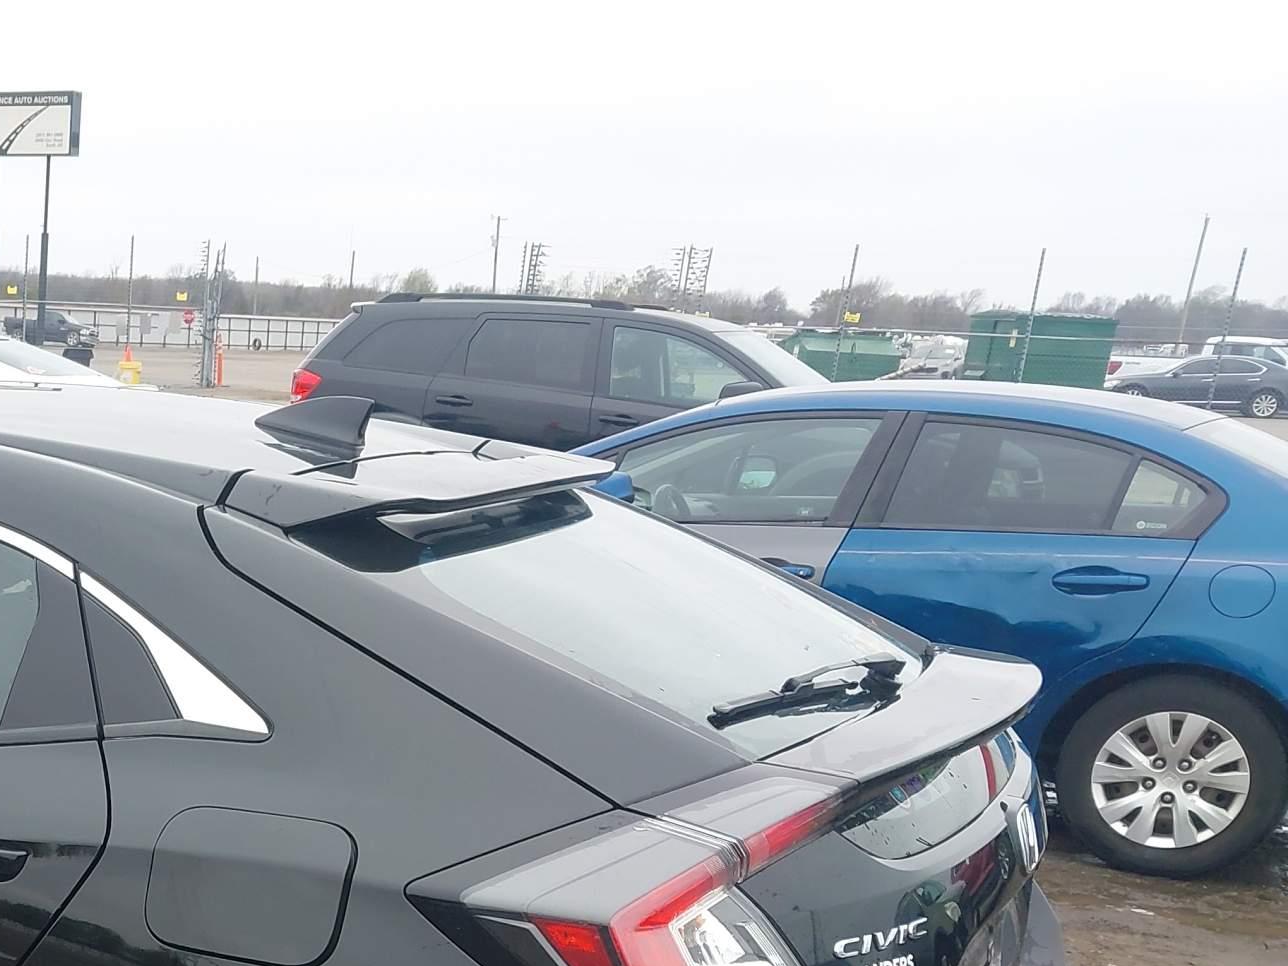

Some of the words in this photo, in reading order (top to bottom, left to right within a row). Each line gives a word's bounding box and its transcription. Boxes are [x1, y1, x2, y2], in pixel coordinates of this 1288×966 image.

[14, 95, 33, 104] AUTO
[34, 95, 69, 104] AUCTIONS
[833, 917, 928, 959] CIVIC
